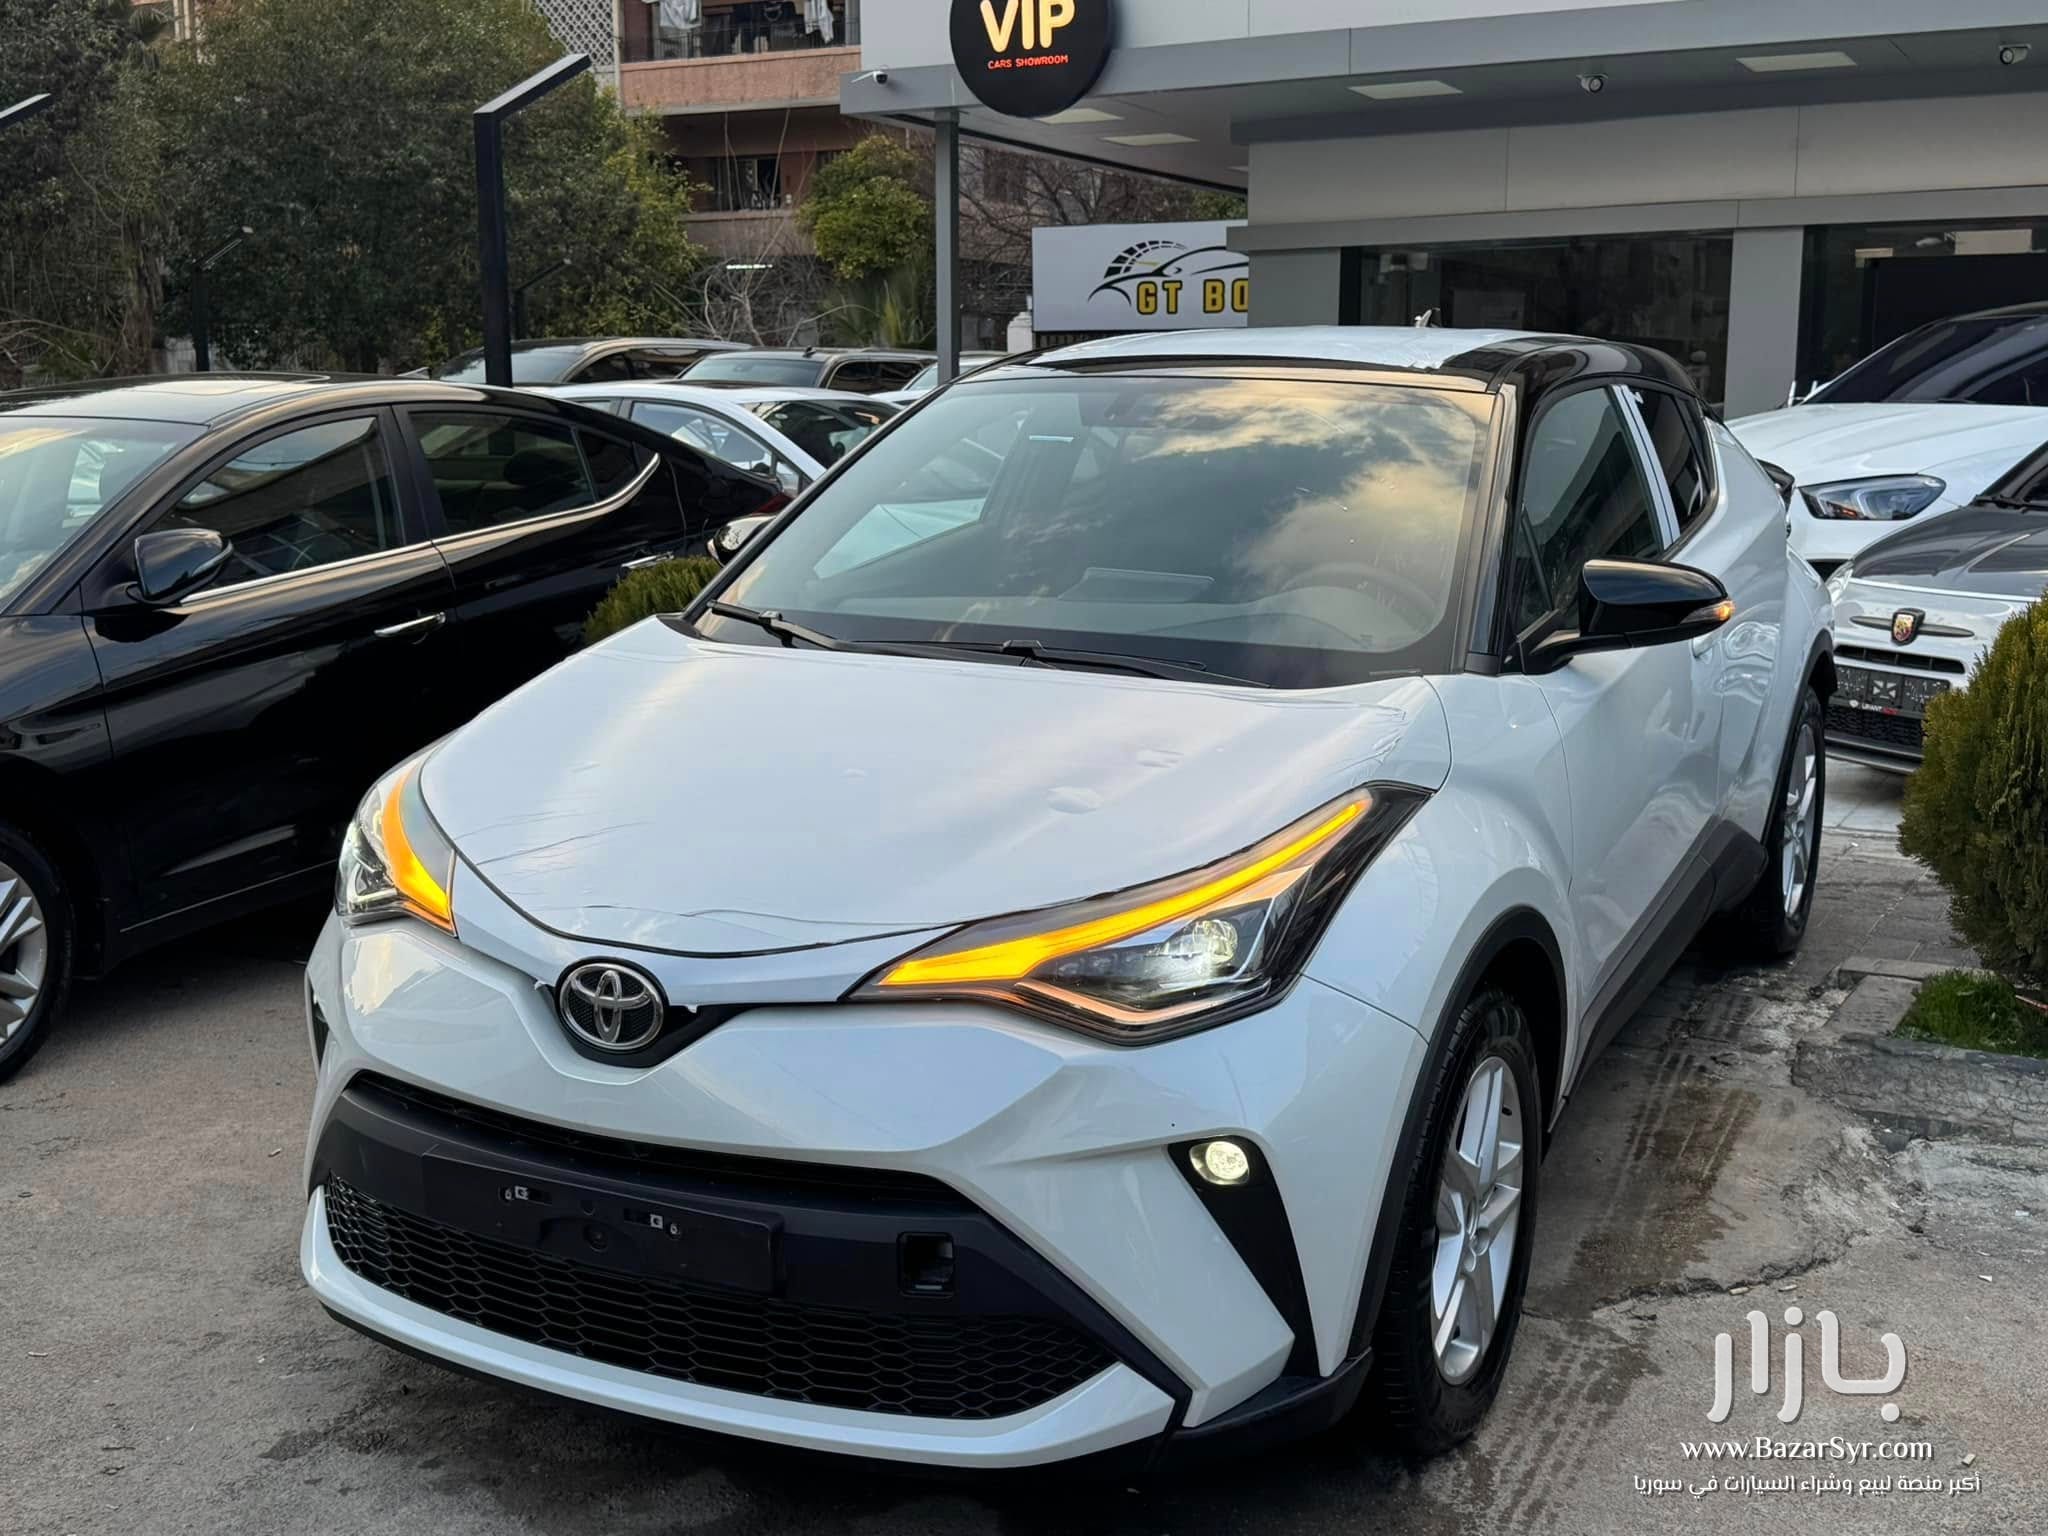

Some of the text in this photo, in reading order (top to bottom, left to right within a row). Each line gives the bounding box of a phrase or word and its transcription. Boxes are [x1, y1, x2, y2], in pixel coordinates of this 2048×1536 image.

[980, 0, 1075, 52] VIP
[987, 54, 1068, 69] CARS SHOWROOM
[1137, 280, 1182, 315] GT
